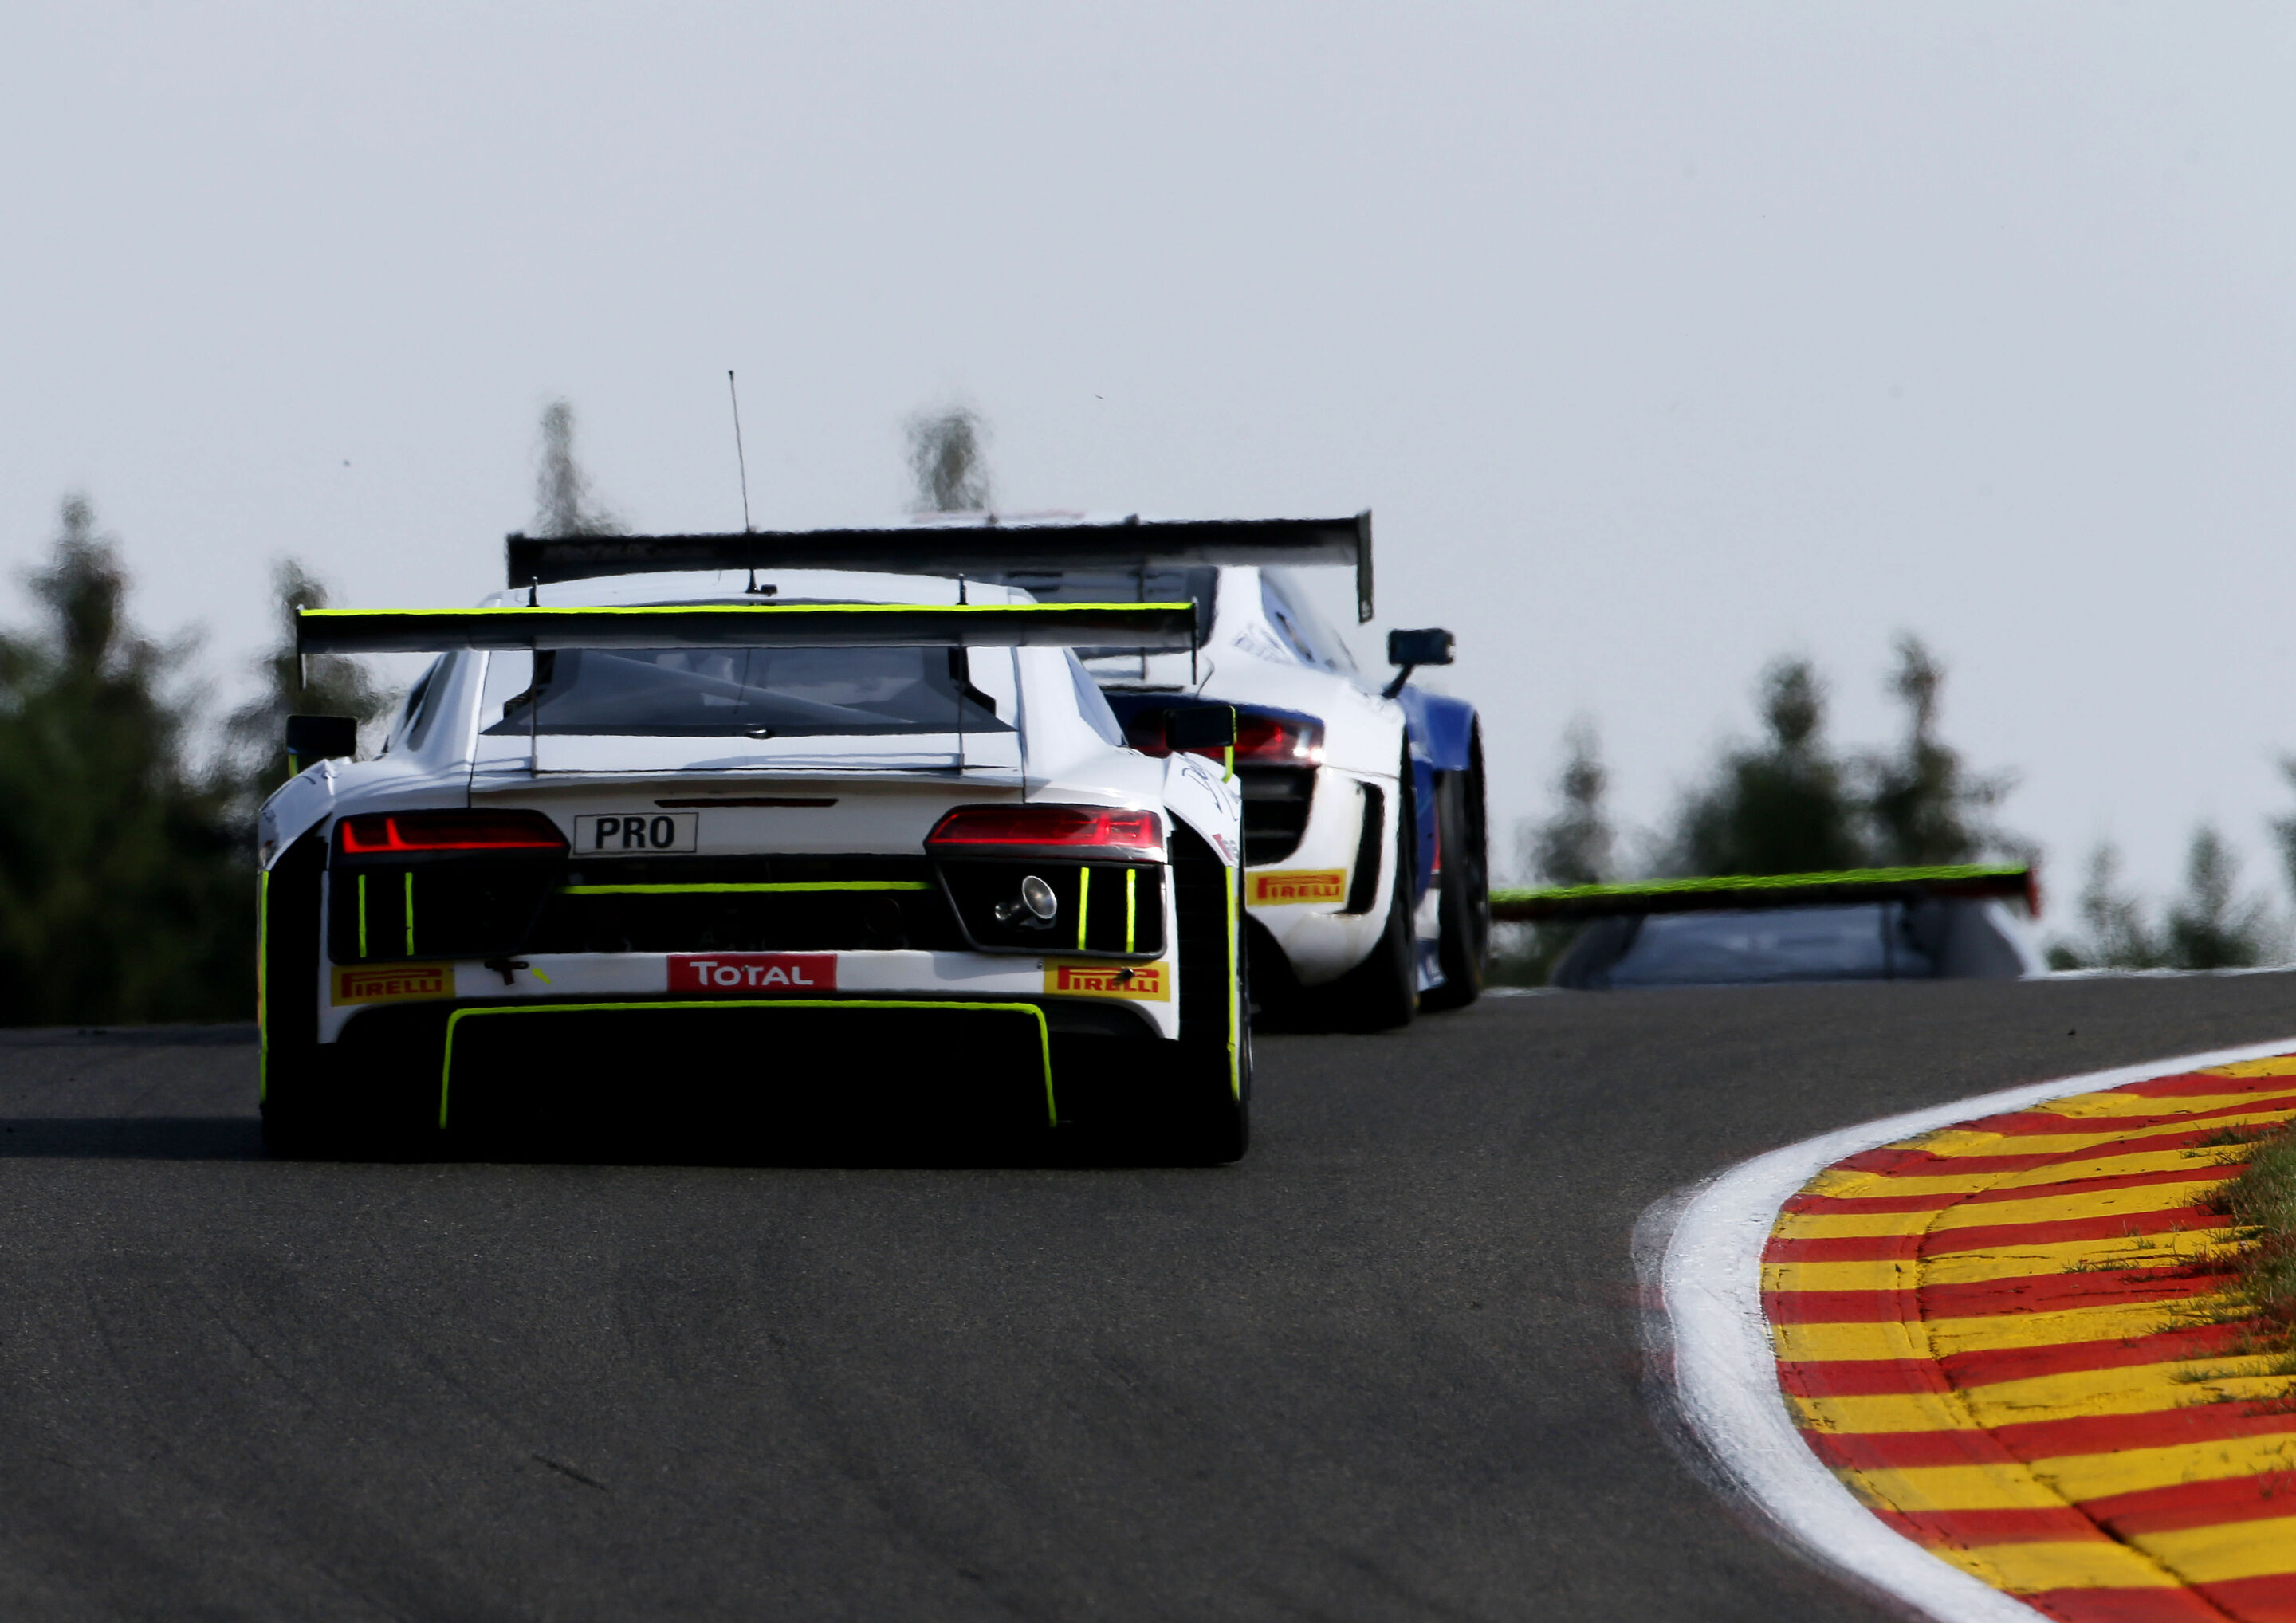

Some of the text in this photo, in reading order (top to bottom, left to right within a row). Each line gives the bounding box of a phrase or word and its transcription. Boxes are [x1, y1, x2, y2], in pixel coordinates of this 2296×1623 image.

[596, 815, 674, 849] PRO
[1257, 874, 1341, 900] PIRELLI
[341, 968, 443, 998] PIRELLI
[1057, 965, 1160, 993] PIRELLI
